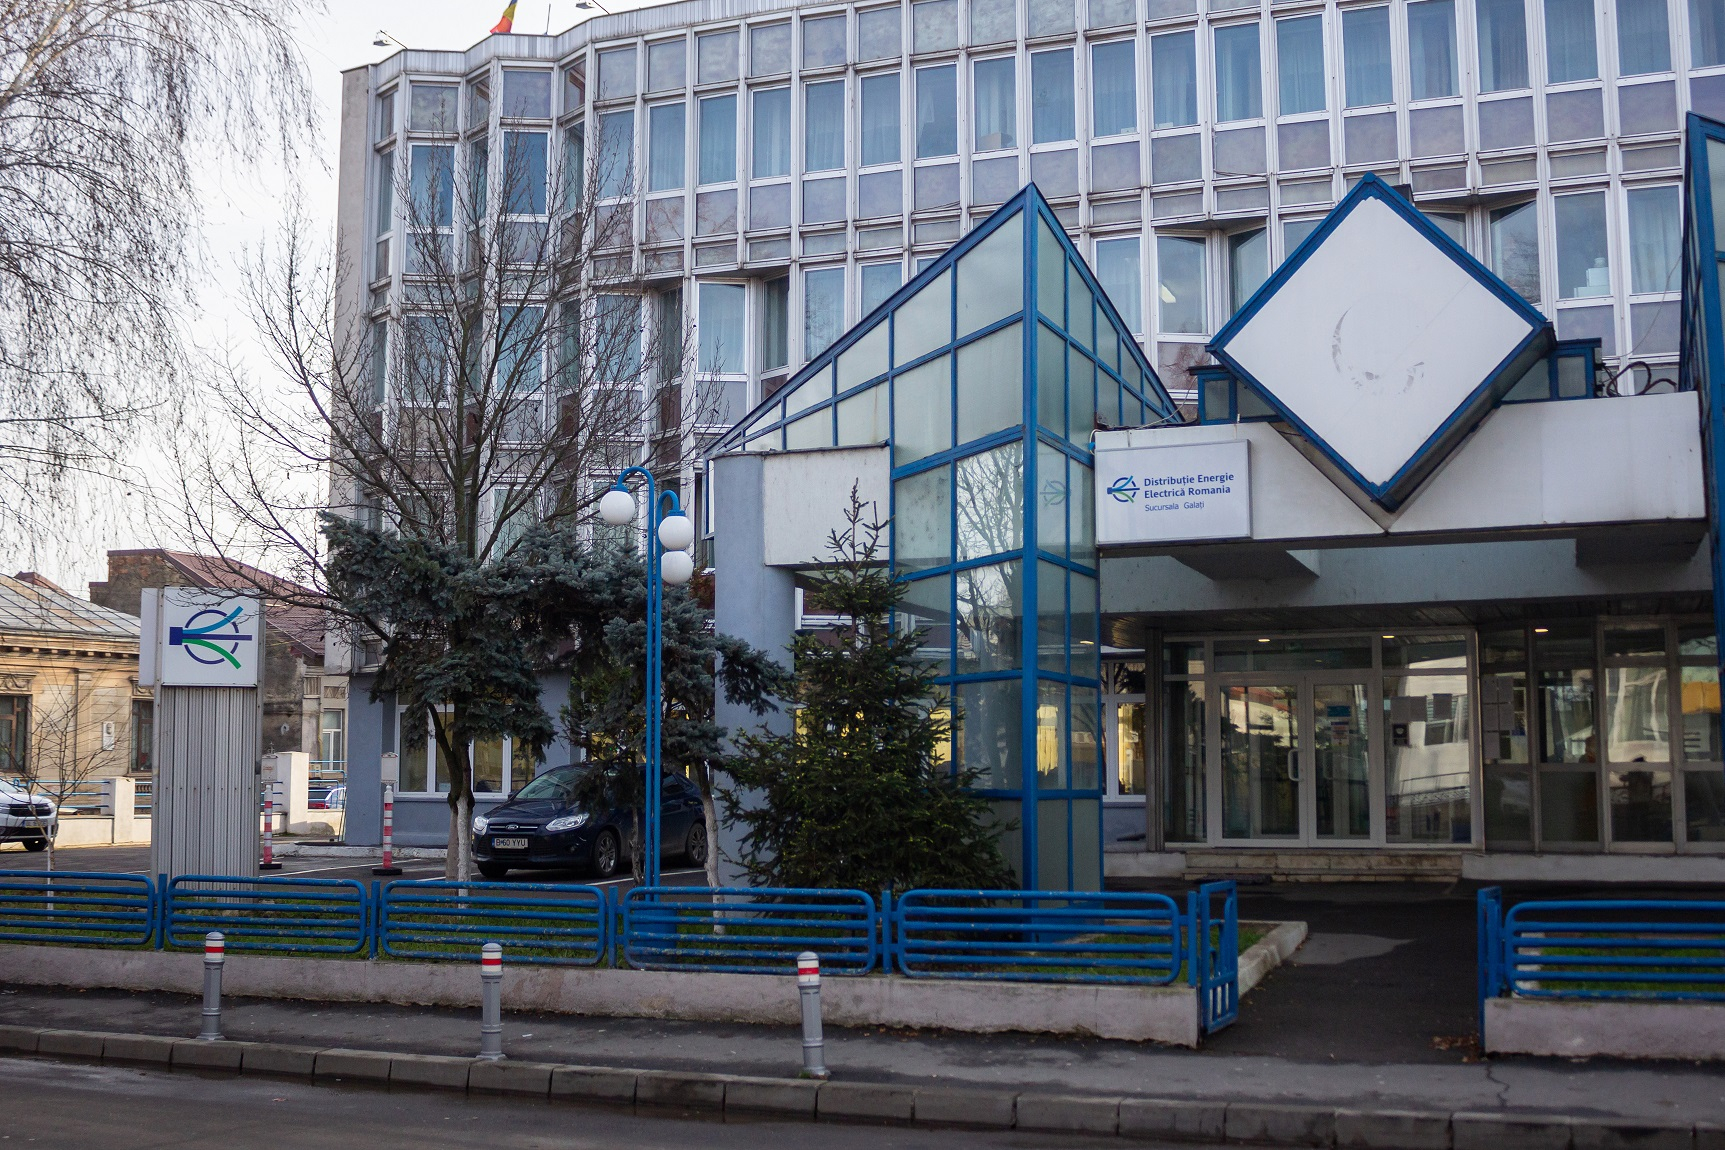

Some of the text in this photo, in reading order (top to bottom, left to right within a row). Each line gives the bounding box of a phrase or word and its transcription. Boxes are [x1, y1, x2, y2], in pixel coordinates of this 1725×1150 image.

[1144, 473, 1234, 486] Distribuție Energie
[1144, 486, 1230, 498] Electrică Romania
[1145, 503, 1179, 512] Sucursala
